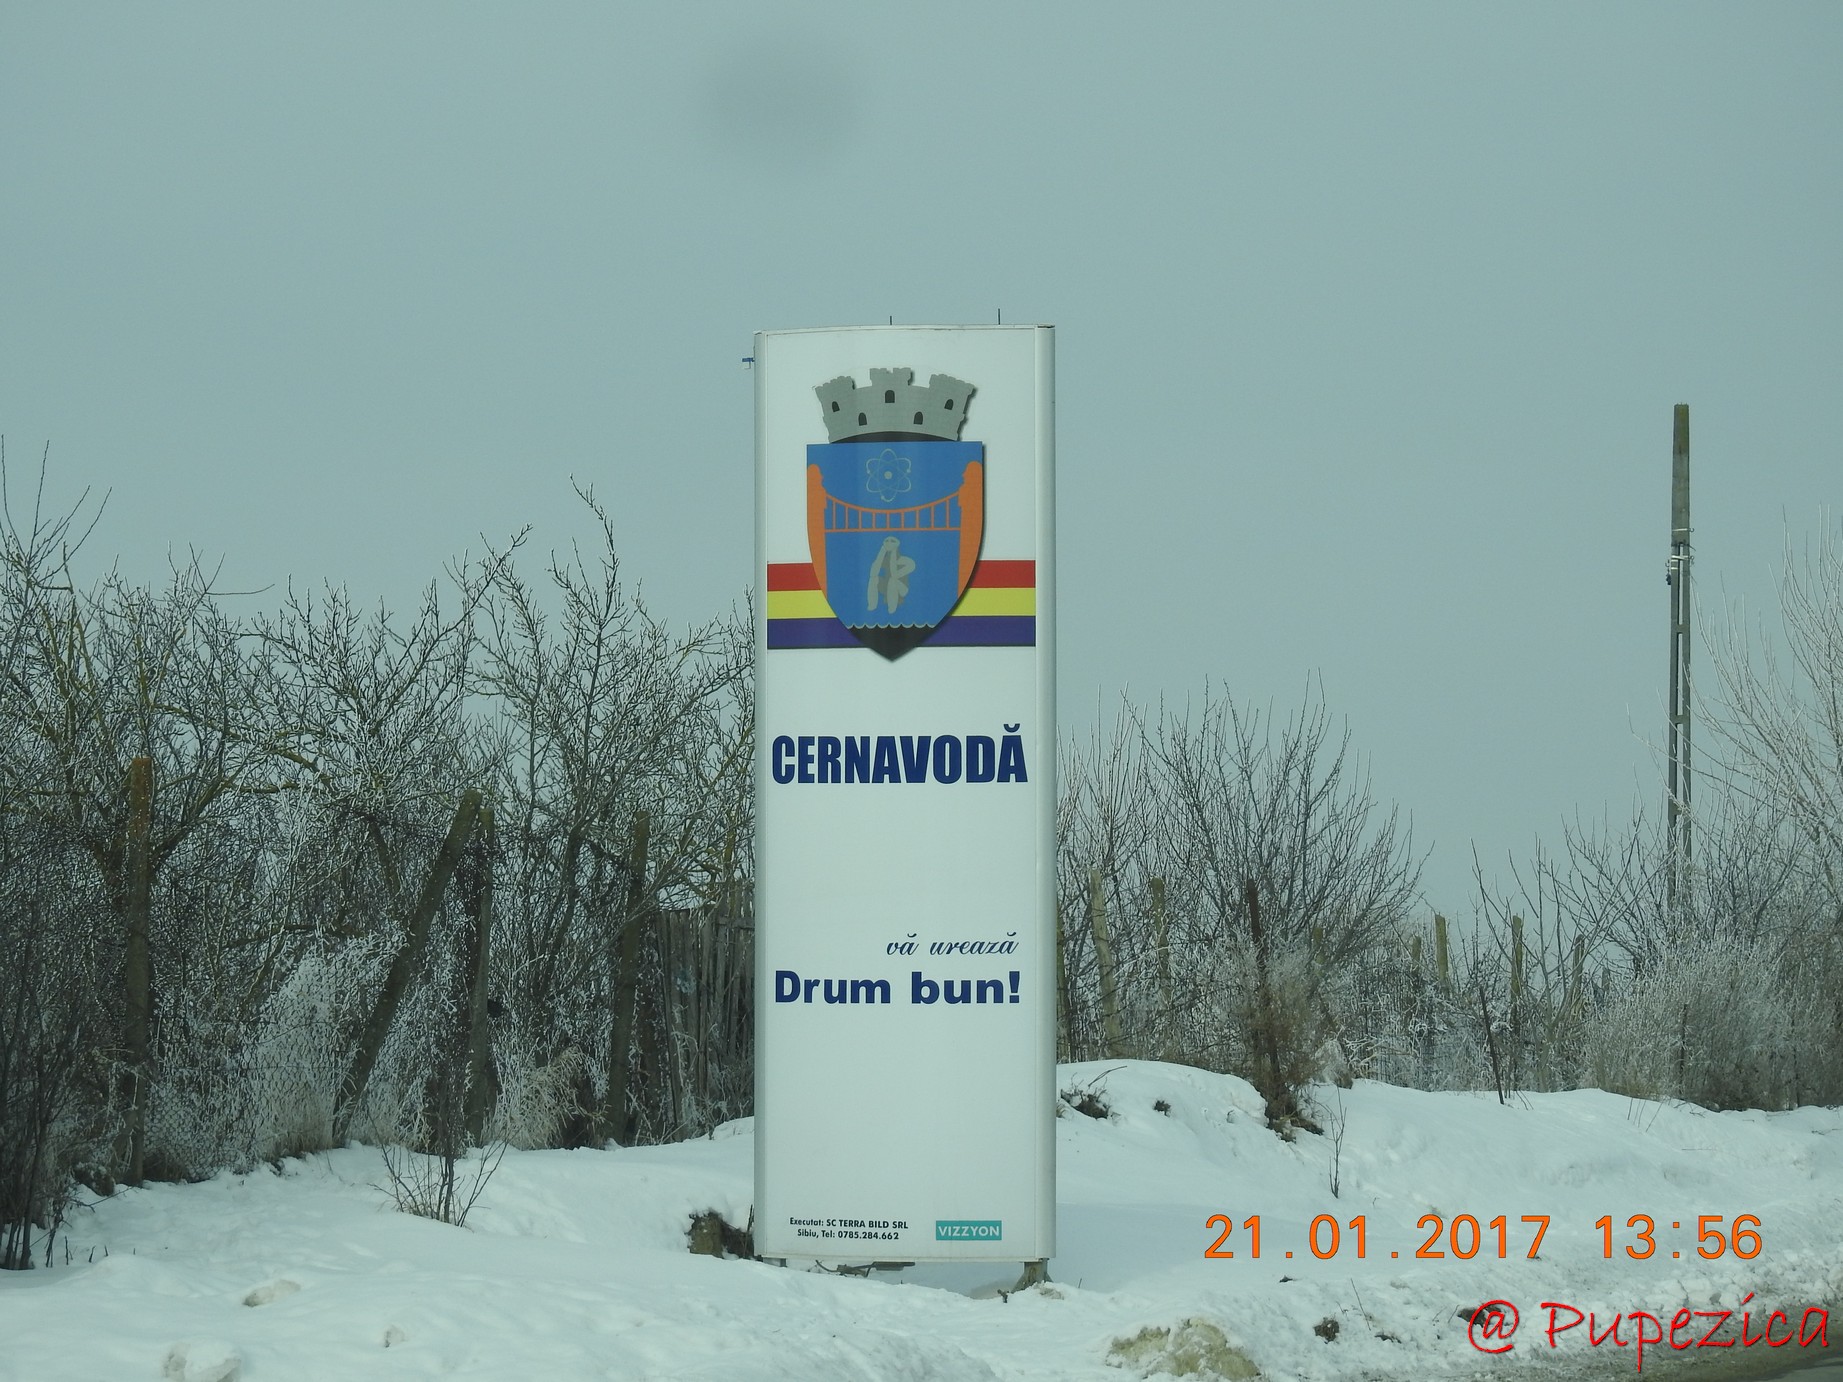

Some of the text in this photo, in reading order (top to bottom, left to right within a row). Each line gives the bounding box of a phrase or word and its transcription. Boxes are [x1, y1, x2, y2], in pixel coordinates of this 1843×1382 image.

[772, 723, 1028, 784] CERNAVODĂ
[886, 931, 1020, 956] vă urează
[775, 970, 1021, 1005] Drum bun!
[789, 1217, 909, 1229] Executat: SC TERRA BILD SRL
[938, 1225, 1000, 1238] VIZZYON
[797, 1228, 900, 1240] Sibiu, Tel: 0785.284.662
